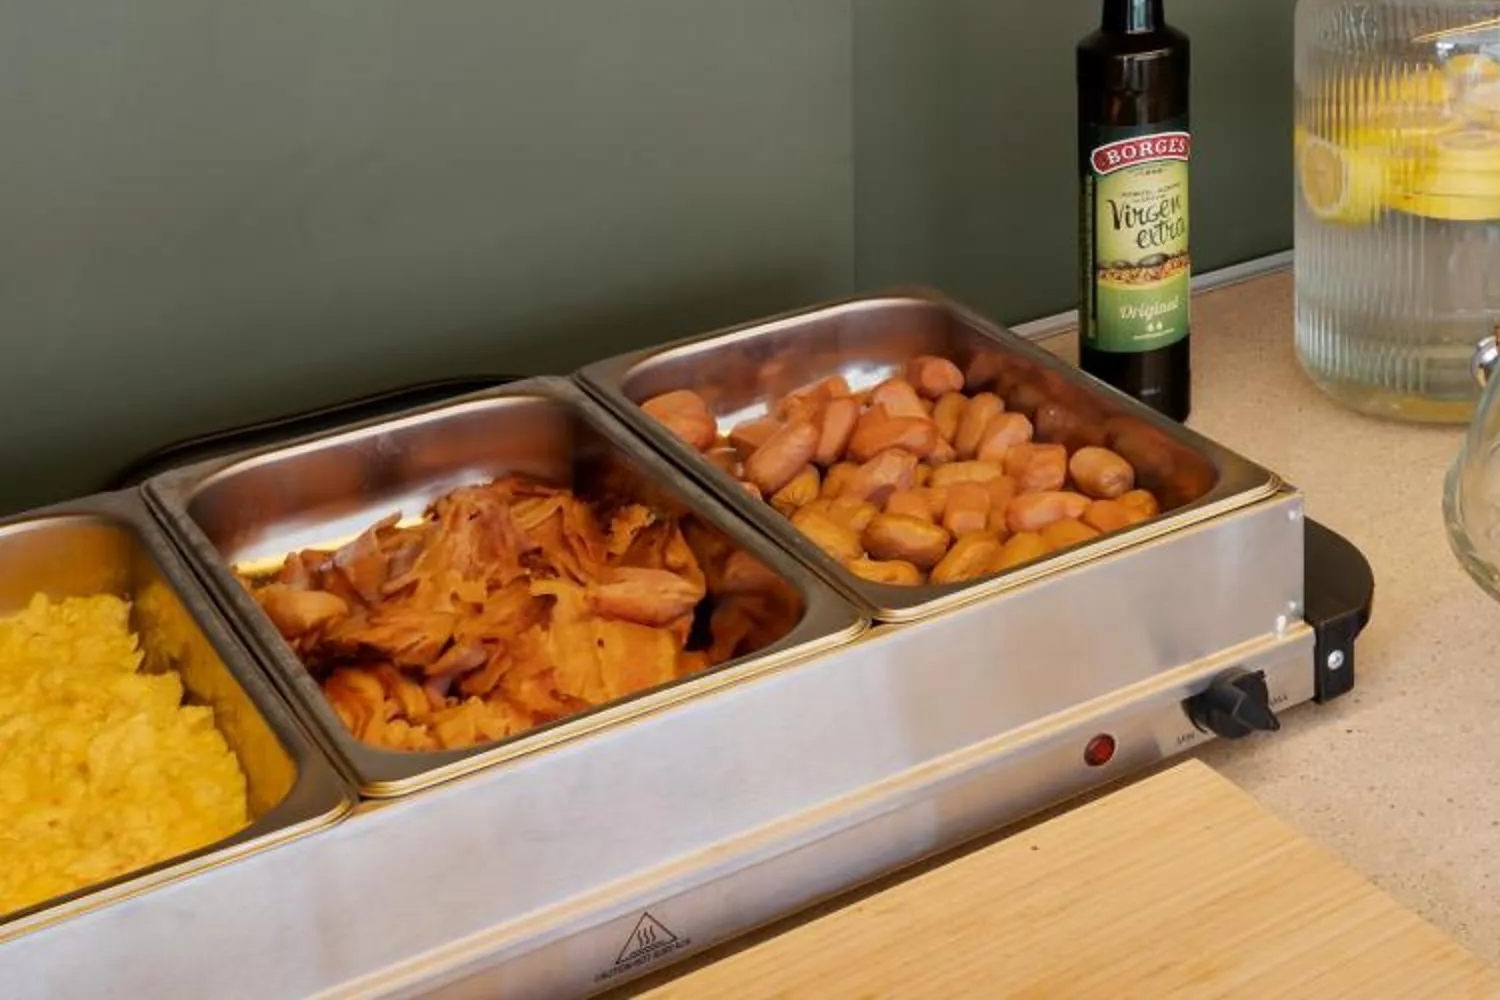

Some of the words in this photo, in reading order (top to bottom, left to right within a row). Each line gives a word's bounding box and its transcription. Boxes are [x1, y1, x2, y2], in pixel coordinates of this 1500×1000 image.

[1106, 138, 1186, 165] BORGES
[1106, 195, 1182, 231] Virgen
[1135, 215, 1186, 249] extra
